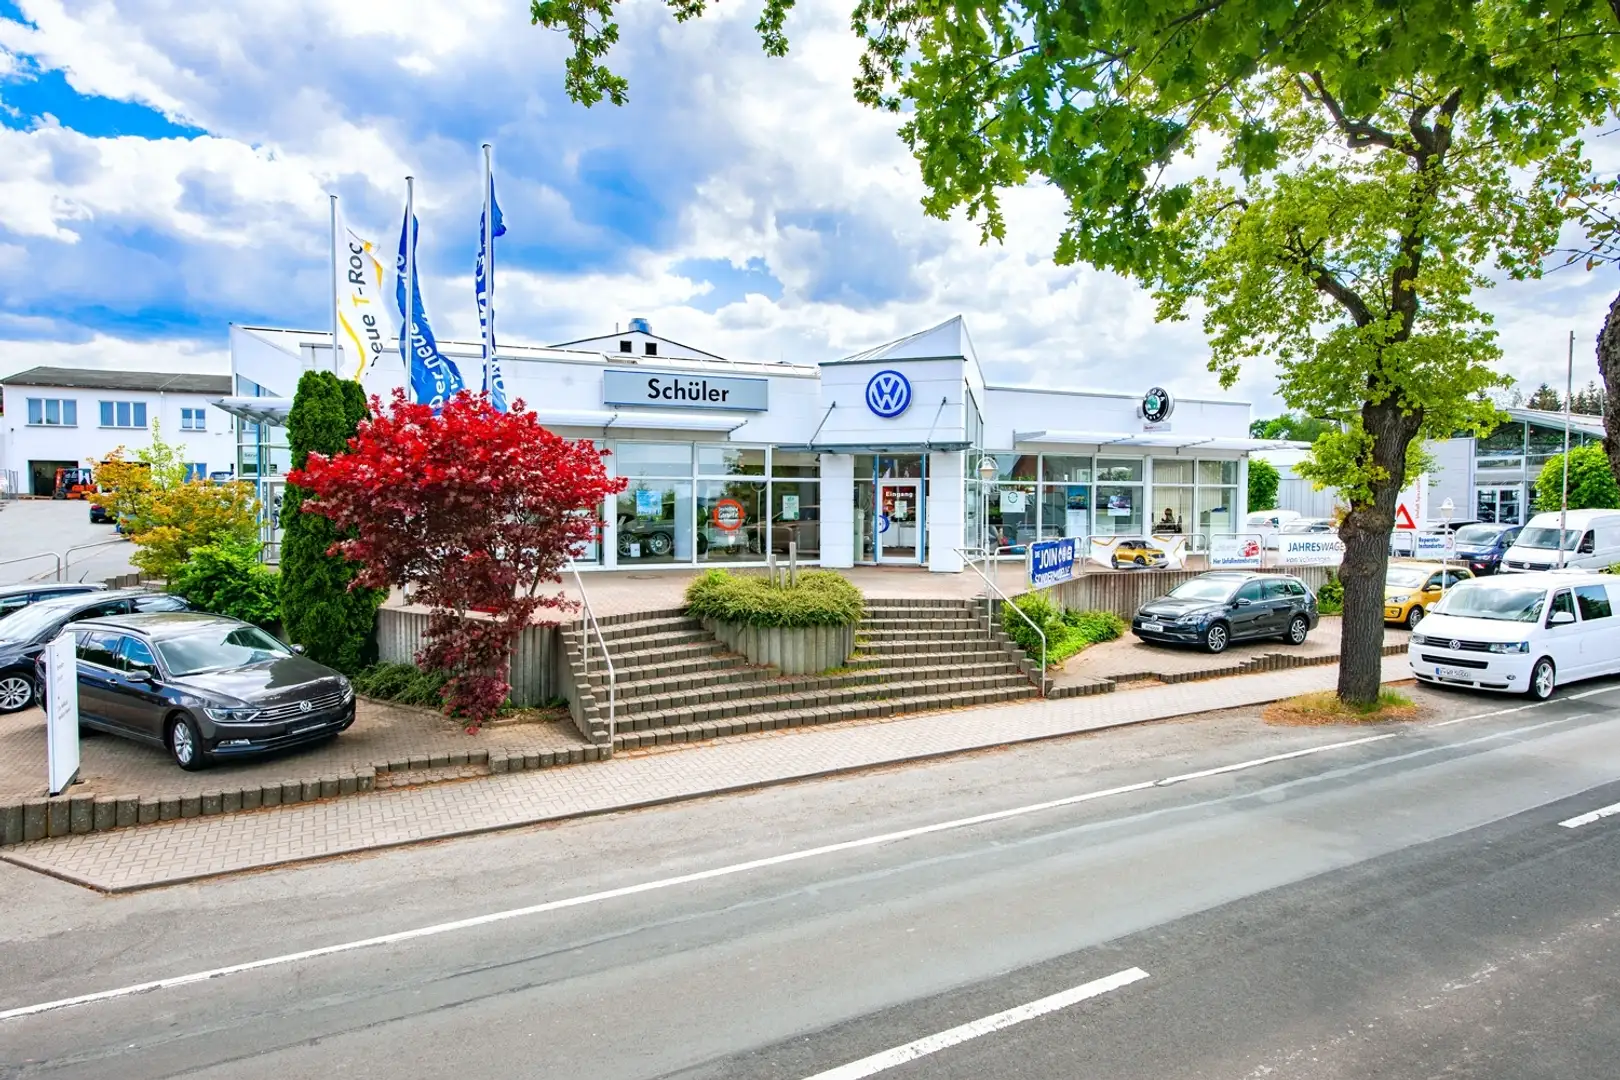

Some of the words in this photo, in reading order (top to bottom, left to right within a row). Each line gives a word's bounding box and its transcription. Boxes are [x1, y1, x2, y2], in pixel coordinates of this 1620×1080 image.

[348, 242, 370, 308] T-Roc
[647, 378, 729, 402] Schüler
[867, 371, 910, 416] VW
[885, 491, 913, 499] Eingang
[1038, 547, 1058, 569] JOIN
[1287, 541, 1345, 553] JAHRESWAGE
